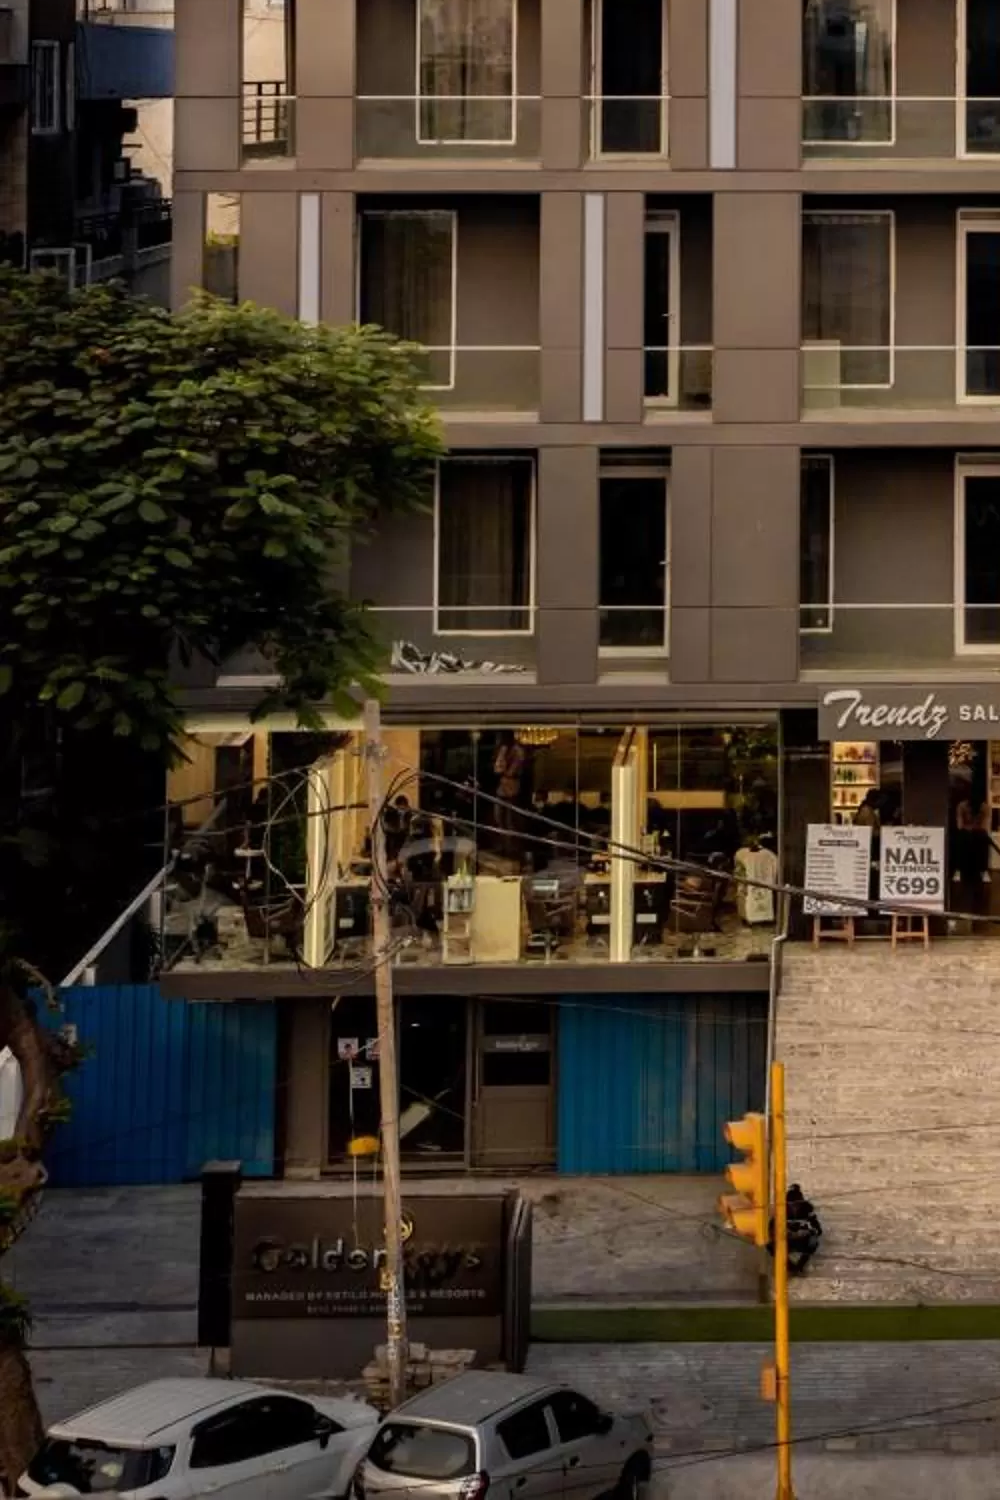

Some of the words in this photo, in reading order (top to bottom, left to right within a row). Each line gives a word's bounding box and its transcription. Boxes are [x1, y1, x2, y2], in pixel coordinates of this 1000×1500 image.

[823, 690, 949, 738] Trendz
[885, 847, 940, 865] NAIL
[884, 875, 940, 896] ₹699
